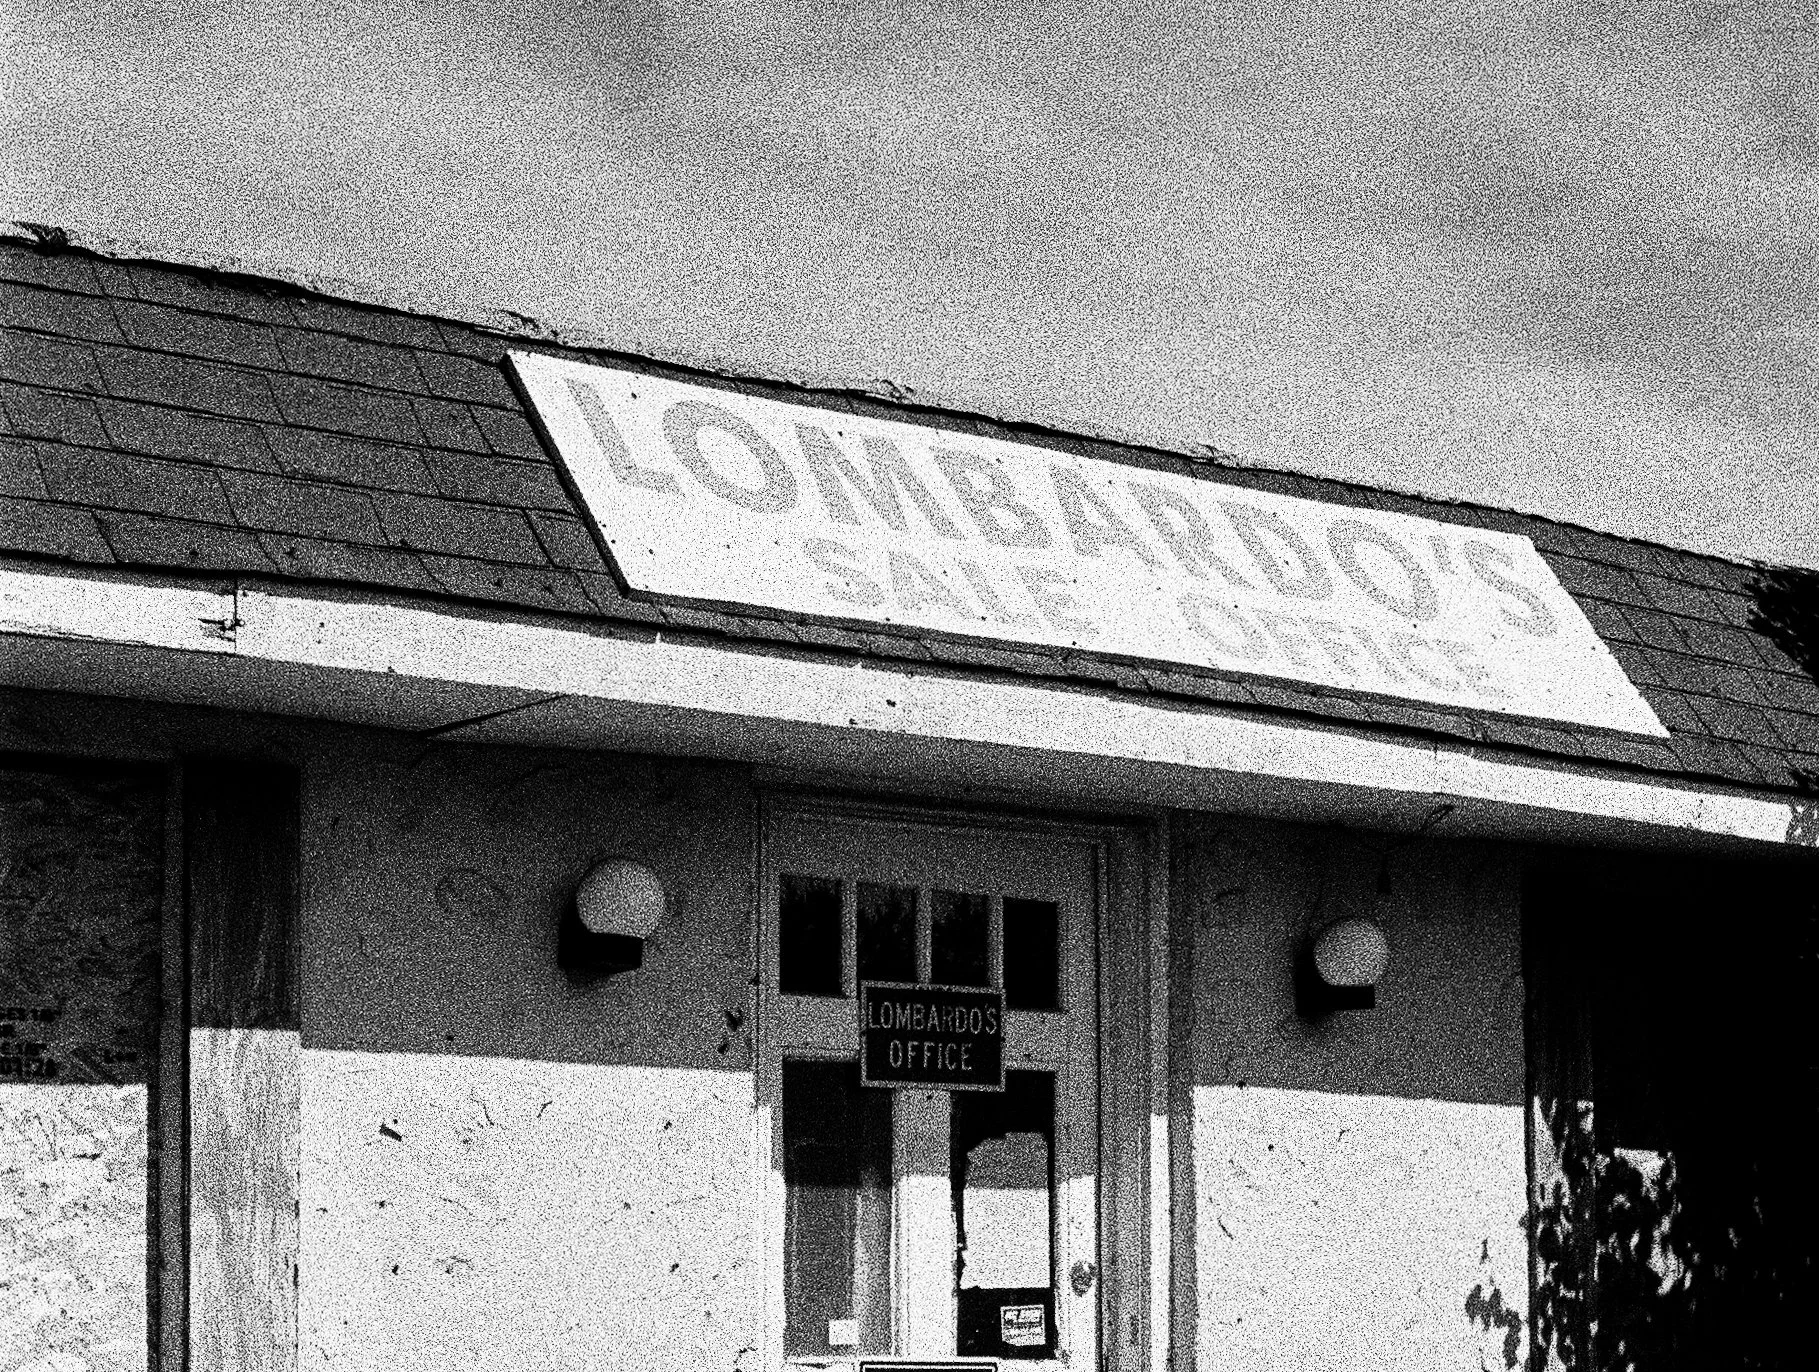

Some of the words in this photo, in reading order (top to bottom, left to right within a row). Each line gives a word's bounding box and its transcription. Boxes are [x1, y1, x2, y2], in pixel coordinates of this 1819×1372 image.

[565, 378, 1558, 638] LOMBARDO'S
[802, 536, 1102, 638] SALE
[1177, 592, 1515, 700] OFFICE
[889, 1039, 973, 1071] OFFICE
